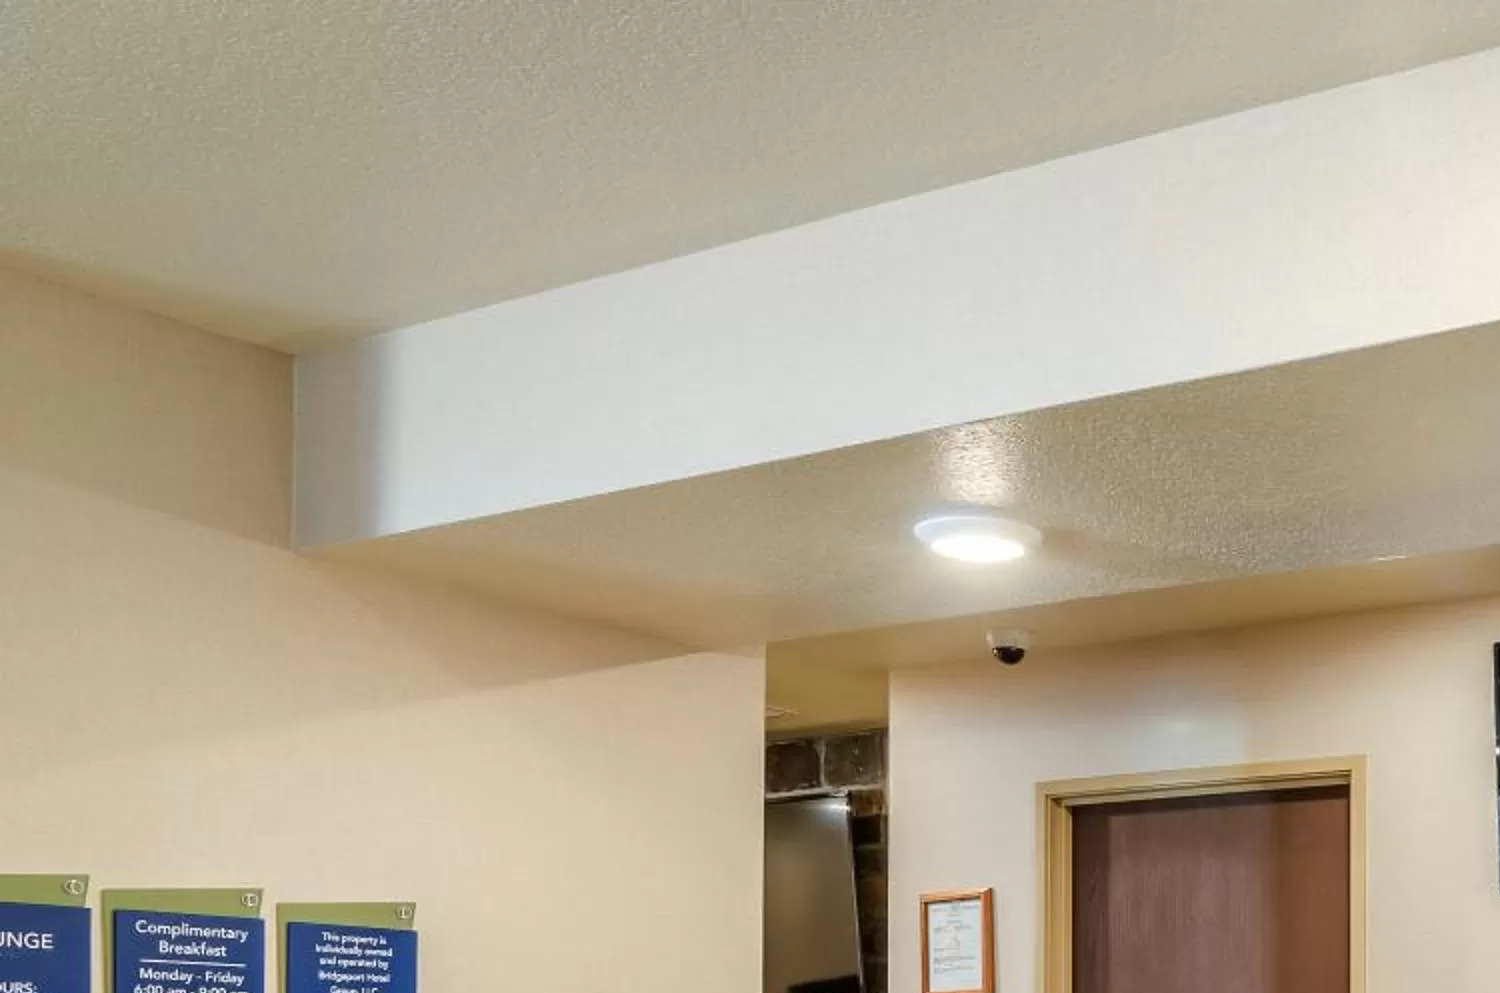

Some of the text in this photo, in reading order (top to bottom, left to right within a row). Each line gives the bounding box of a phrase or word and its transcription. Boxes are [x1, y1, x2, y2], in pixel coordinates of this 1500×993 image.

[135, 919, 248, 943] Complimentary
[321, 931, 340, 942] This
[341, 935, 378, 946] property
[159, 940, 227, 957] Breakfast
[319, 956, 389, 971] and operated by
[139, 968, 193, 984] Monday
[205, 971, 245, 986] Friday
